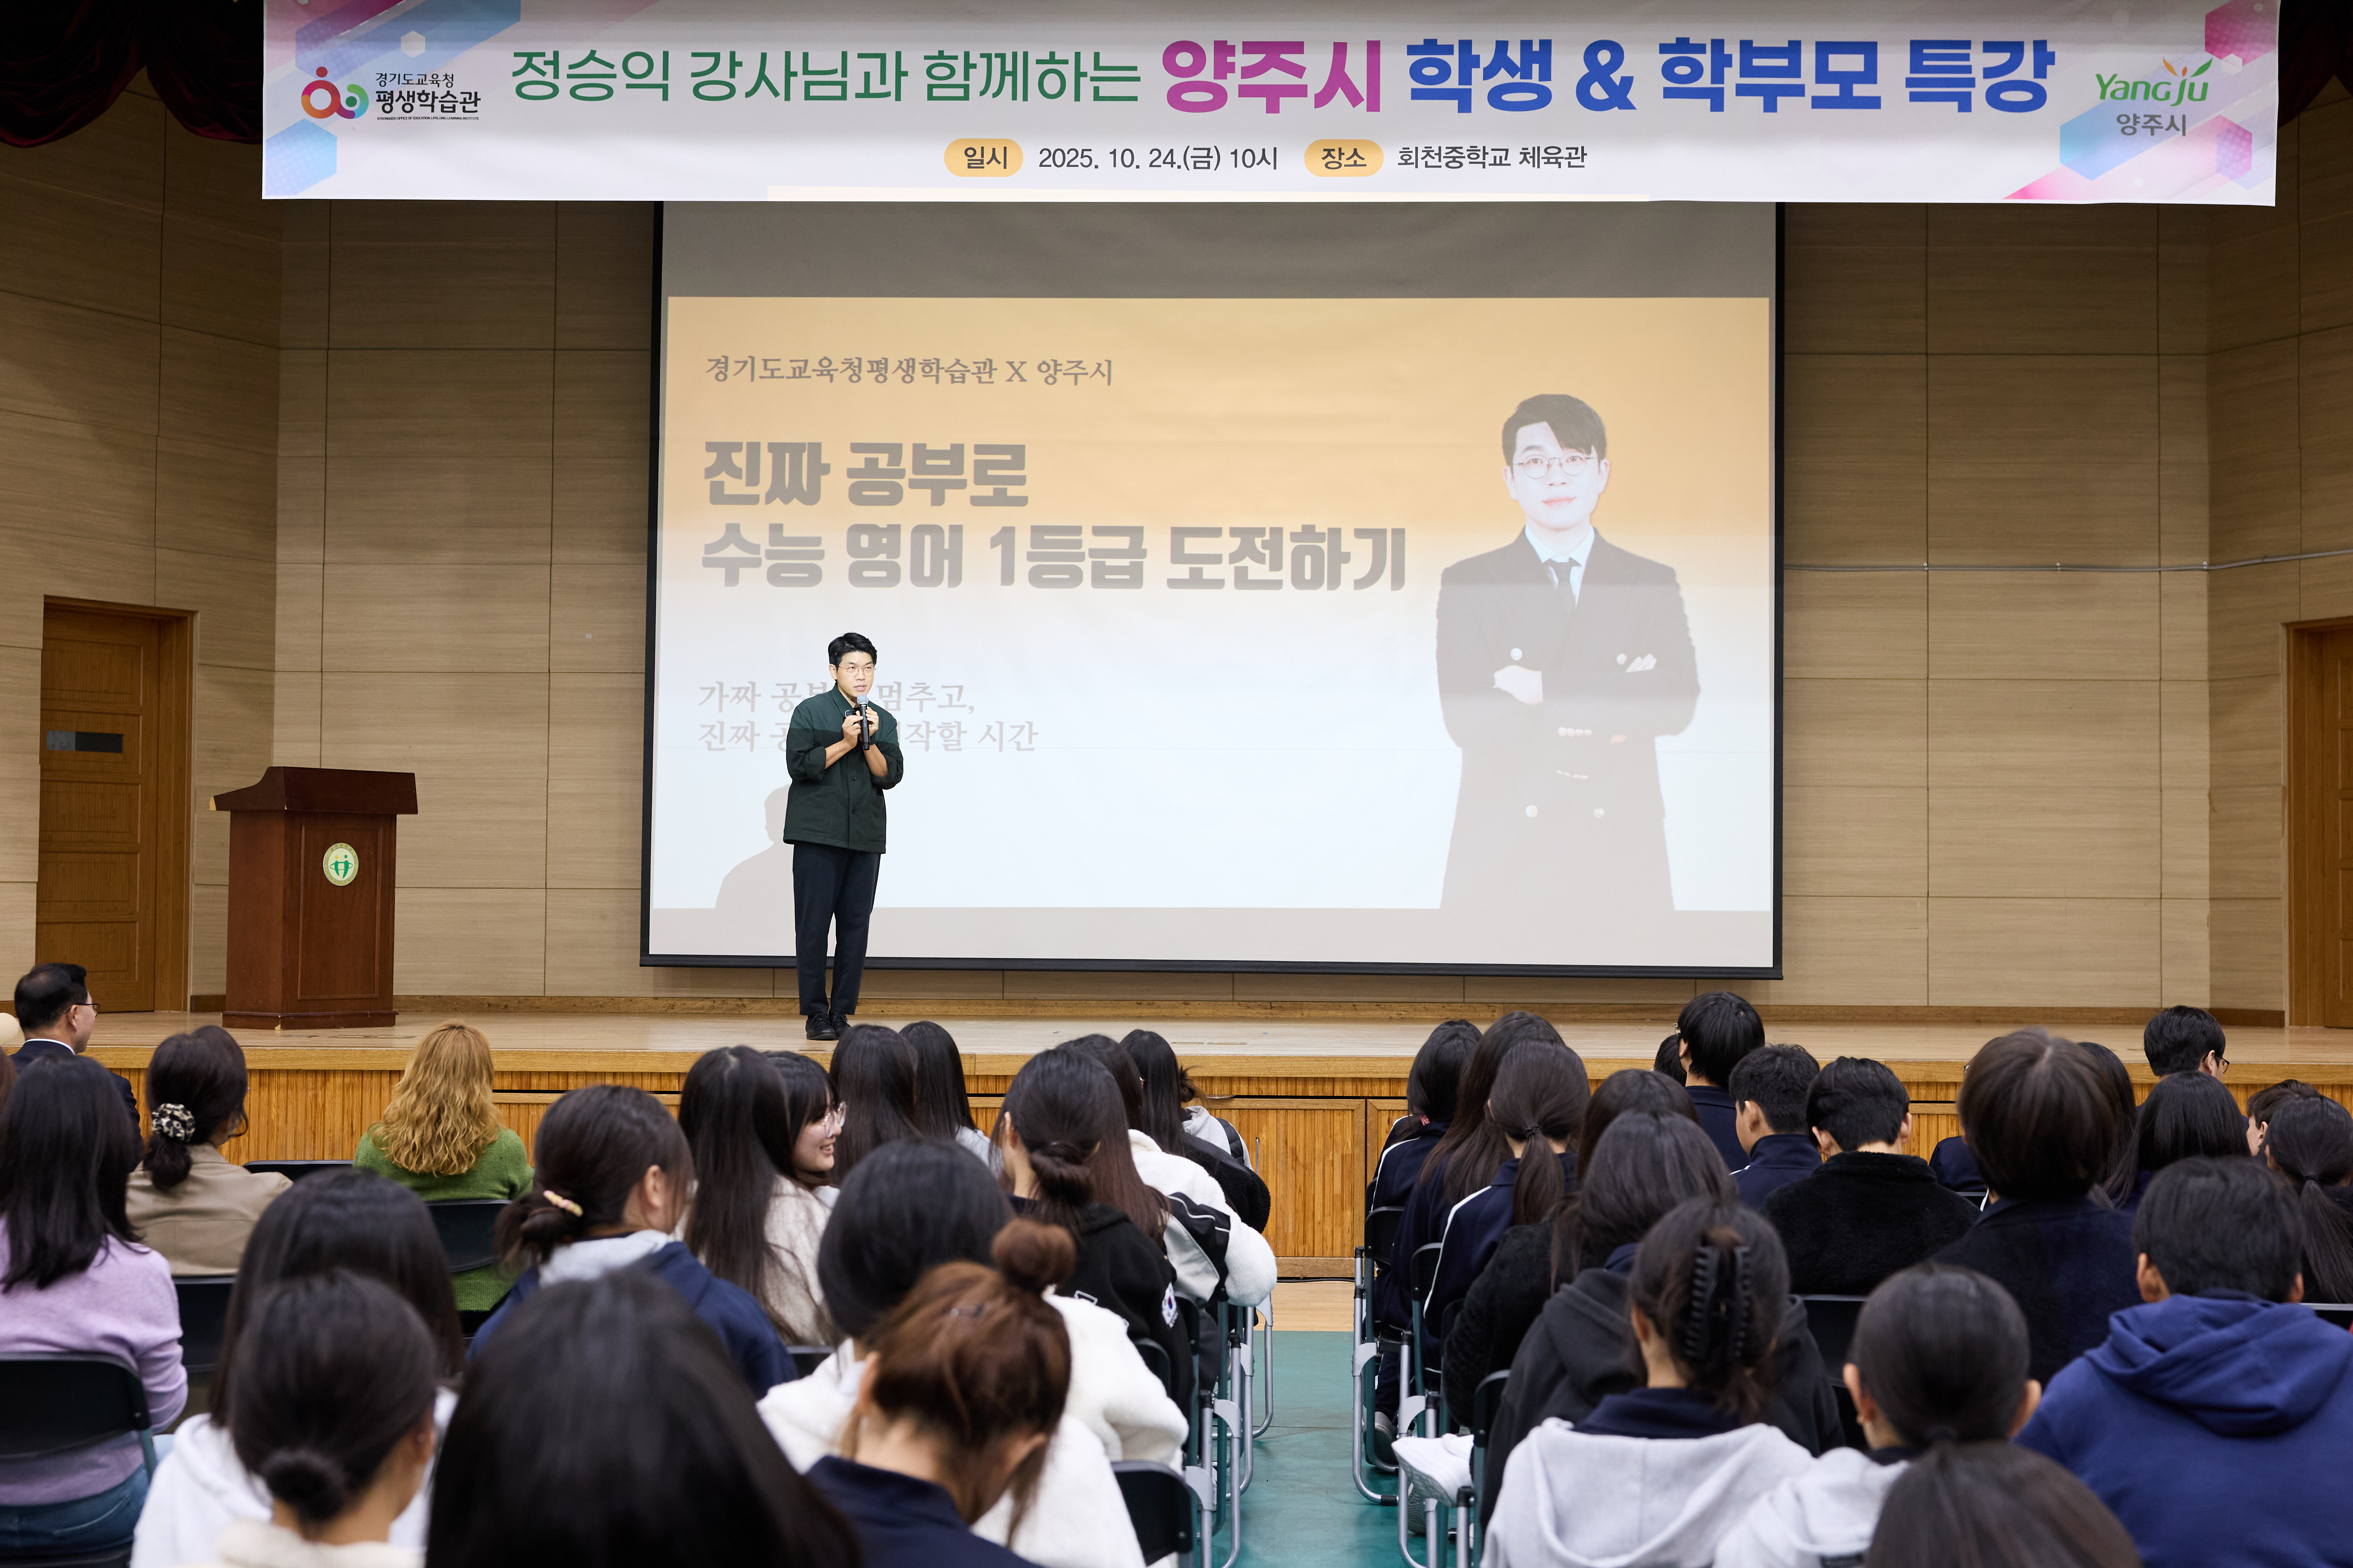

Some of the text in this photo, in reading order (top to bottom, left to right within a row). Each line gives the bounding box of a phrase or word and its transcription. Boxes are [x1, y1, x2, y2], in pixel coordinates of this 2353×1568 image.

[376, 73, 454, 88] 경기도교육청
[512, 37, 2056, 114] 정승익 강사님과 함께하는 양주시 학생 & 학부모 특강
[376, 90, 481, 114] 평생학습관
[2116, 113, 2186, 136] 양주시
[964, 145, 1277, 171] 일시 2025. 10. 24.(금) 10시
[1321, 145, 1587, 170] 장소 회천중학교 체육관
[706, 355, 1112, 386] 경기도교육청평생학습관 X 양주시
[704, 441, 1028, 507] 진짜 공부로
[702, 523, 1406, 591] 수능 영어 1등급 도전하기
[699, 682, 761, 713] 가짜
[876, 681, 975, 714] 멈추고,
[698, 721, 760, 752] 진짜
[977, 721, 1039, 753] 시간
